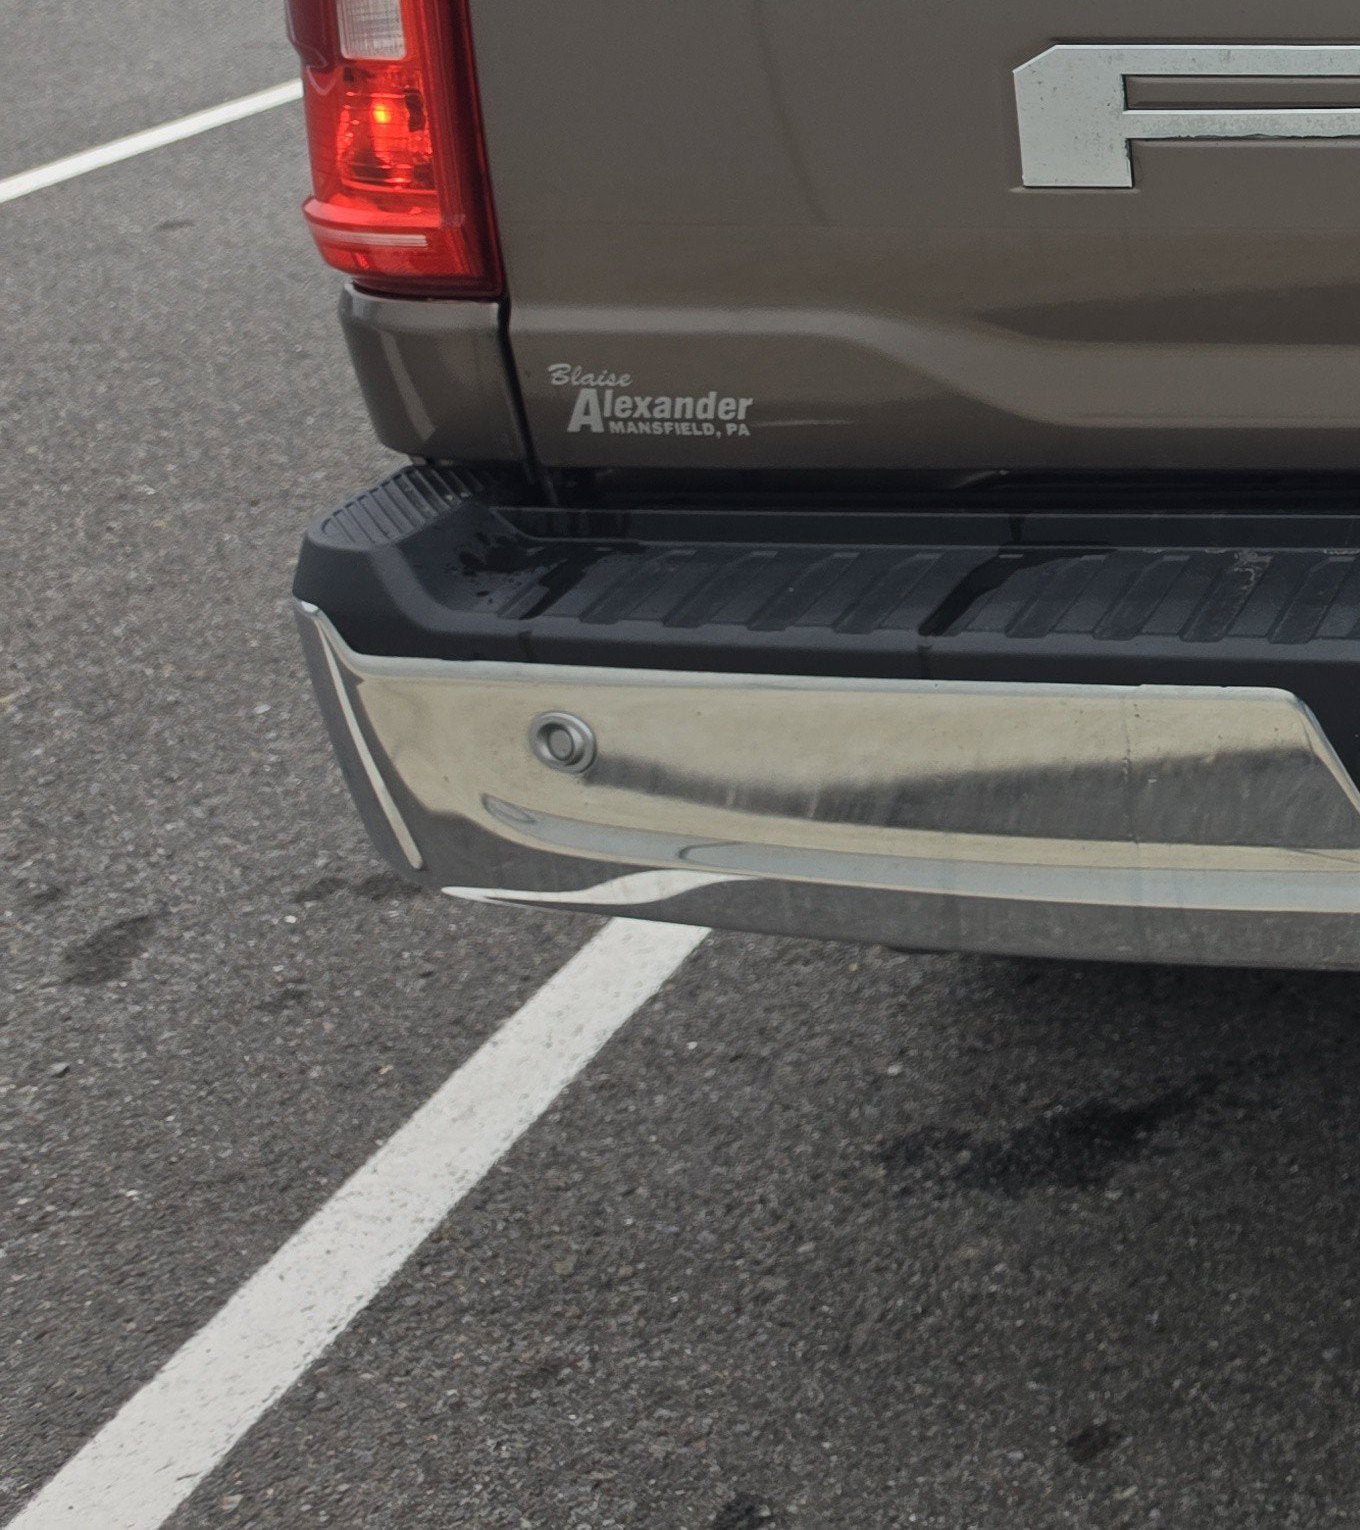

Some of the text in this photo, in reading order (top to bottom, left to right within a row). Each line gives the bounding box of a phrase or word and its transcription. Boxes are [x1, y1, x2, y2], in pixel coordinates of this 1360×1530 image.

[548, 363, 634, 387] Blaise
[566, 387, 754, 434] Alexander
[608, 420, 751, 439] MANSFIELD, PA
